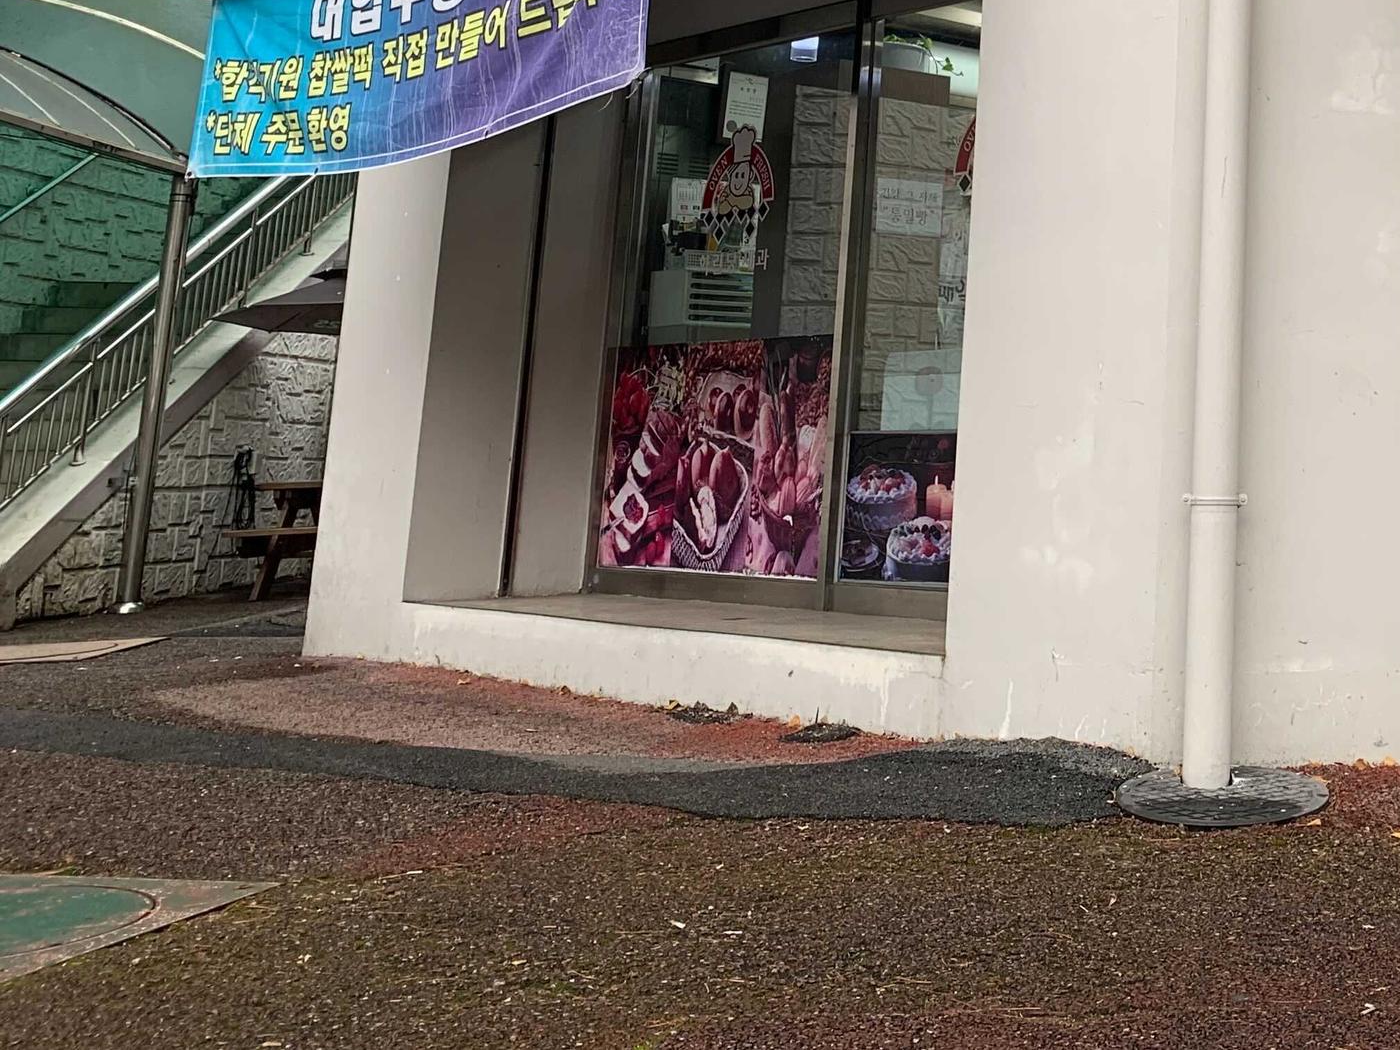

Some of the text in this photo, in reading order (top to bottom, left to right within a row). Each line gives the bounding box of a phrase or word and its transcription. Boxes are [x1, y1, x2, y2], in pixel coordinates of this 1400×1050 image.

[307, 42, 374, 98] 찹쌀떡
[381, 27, 430, 83] 직접
[435, 0, 512, 70] 만들어
[708, 153, 771, 192] OVEN FRESH
